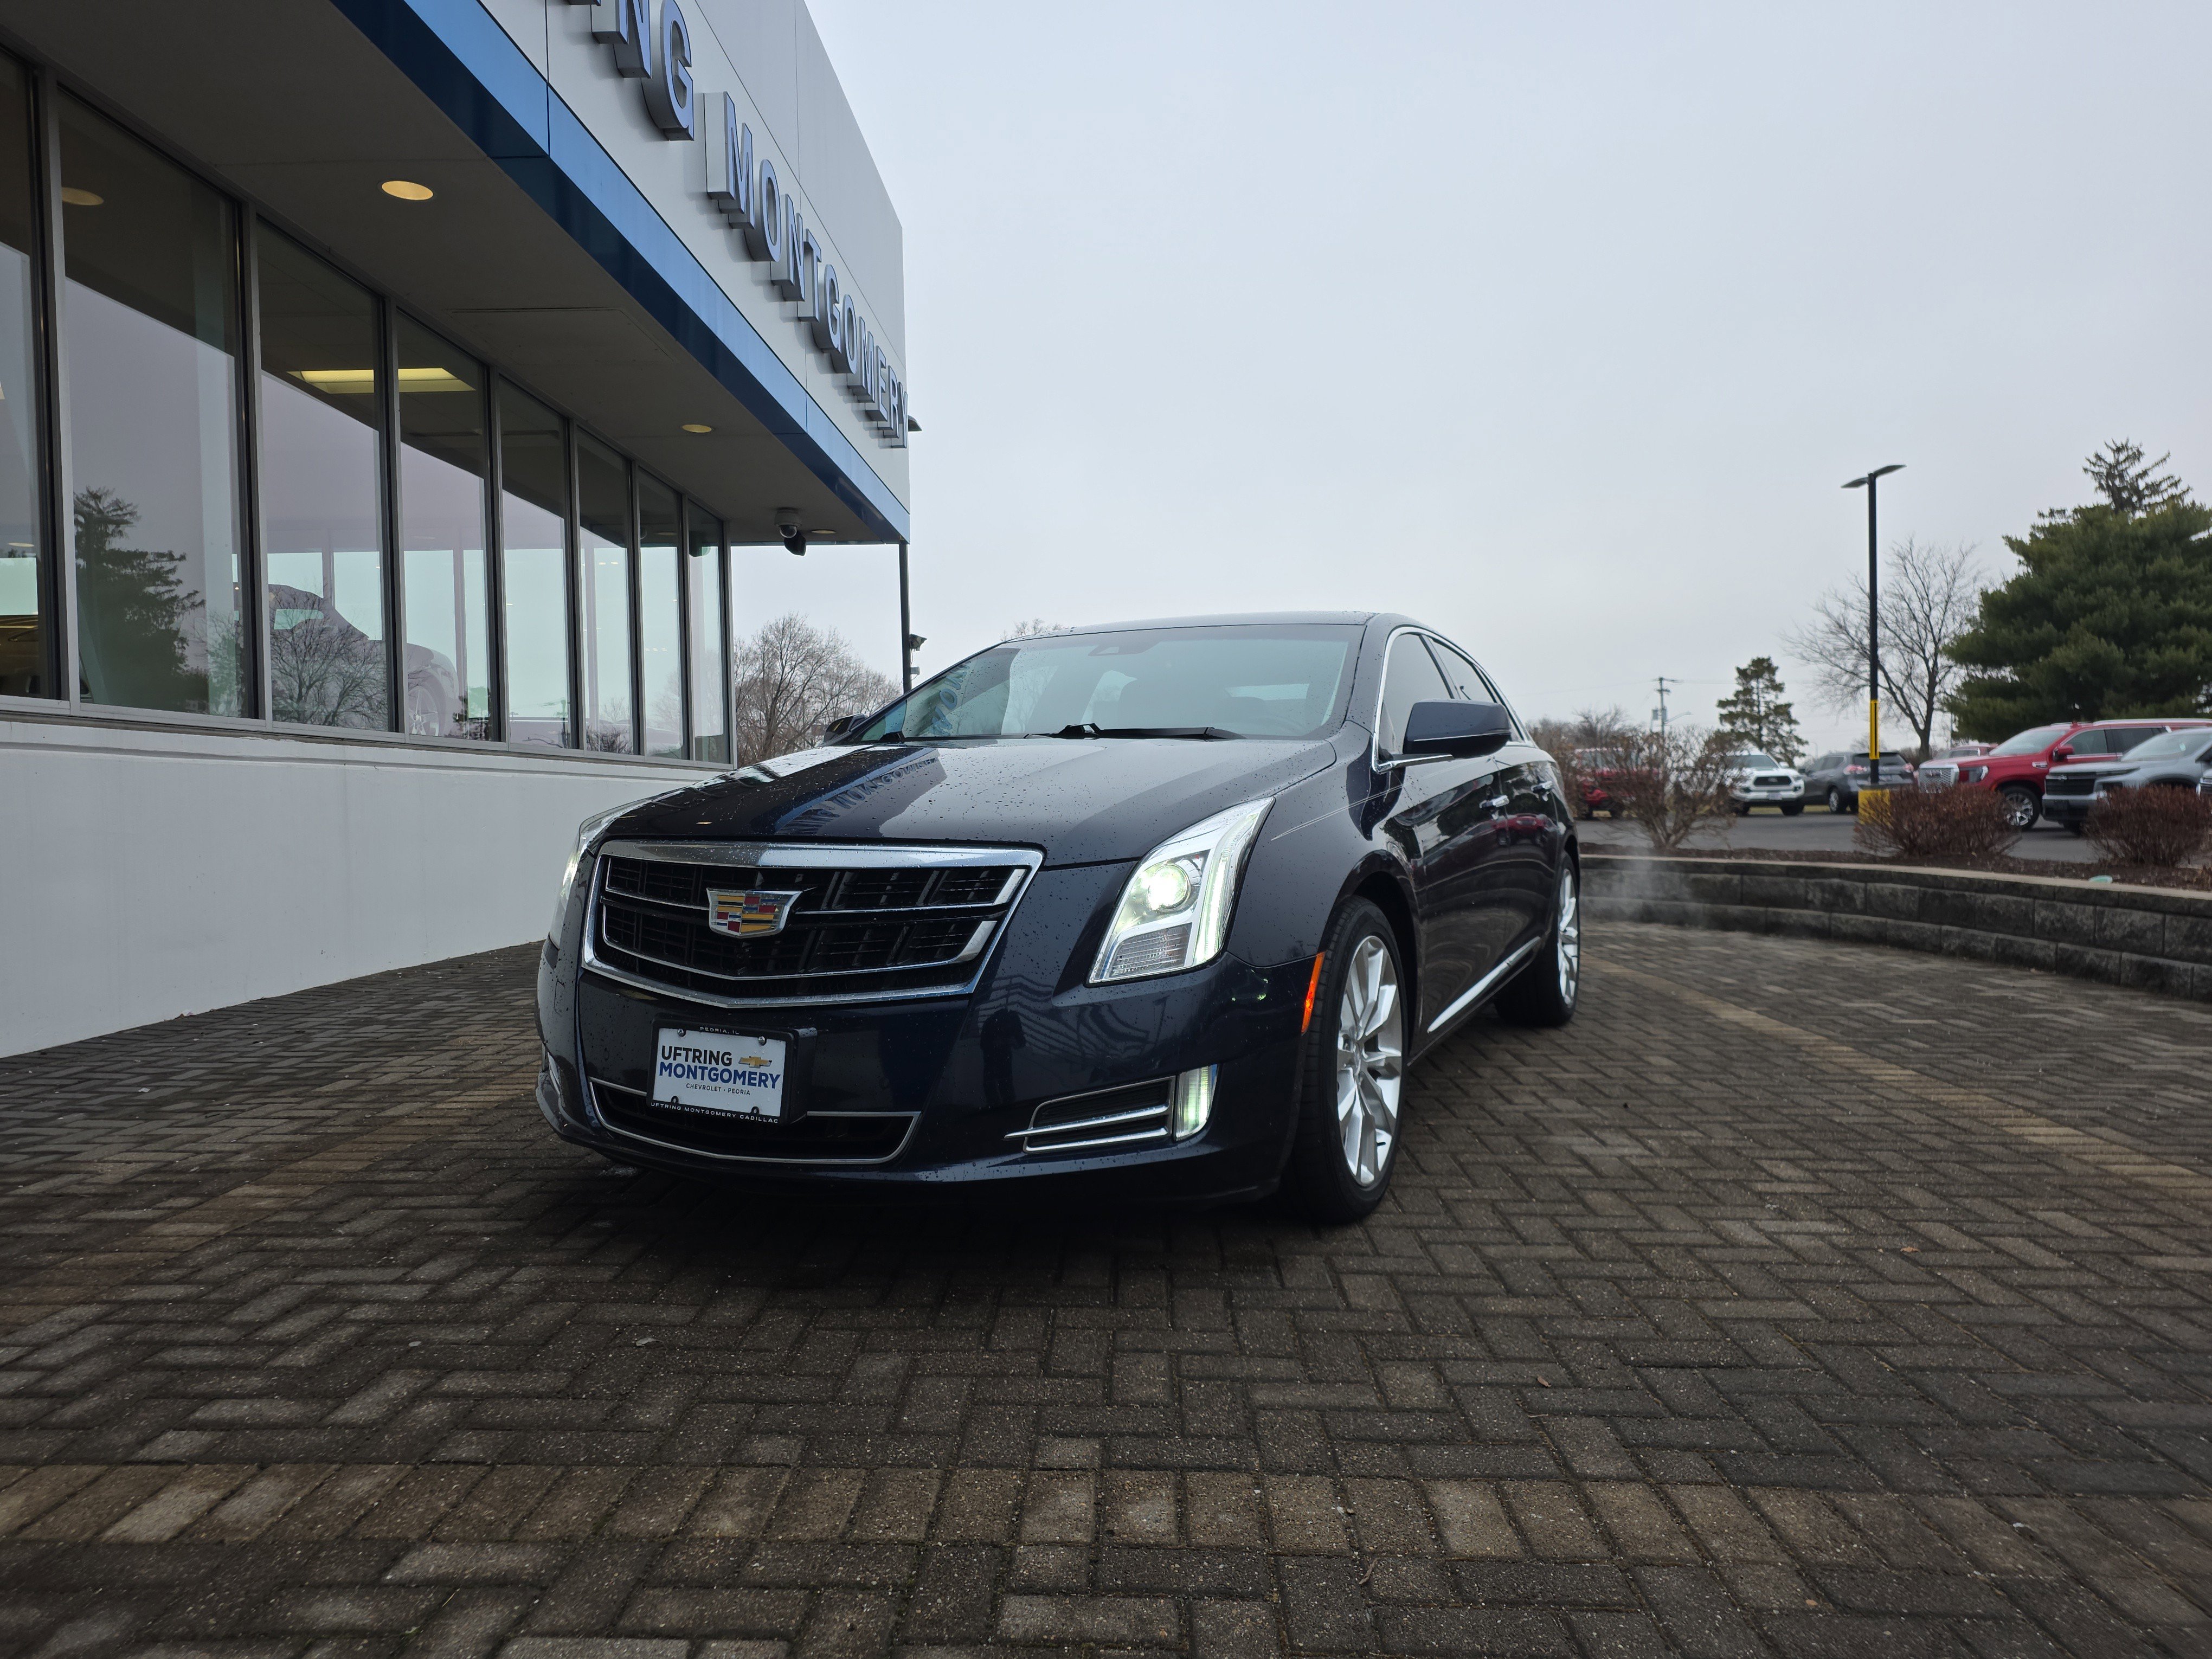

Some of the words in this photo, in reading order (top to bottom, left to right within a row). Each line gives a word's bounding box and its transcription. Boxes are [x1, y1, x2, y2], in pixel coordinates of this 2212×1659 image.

[704, 91, 908, 449] MONTGOMERY
[661, 1045, 732, 1067] UFTRING
[659, 1061, 781, 1089] MONTGOMERY
[686, 1083, 722, 1092] CHEVROLET
[728, 1088, 750, 1096] PEORIA
[651, 1102, 681, 1110] UFTRING
[684, 1107, 736, 1118] MONTGOMERY
[740, 1114, 779, 1124] CADILLAC
